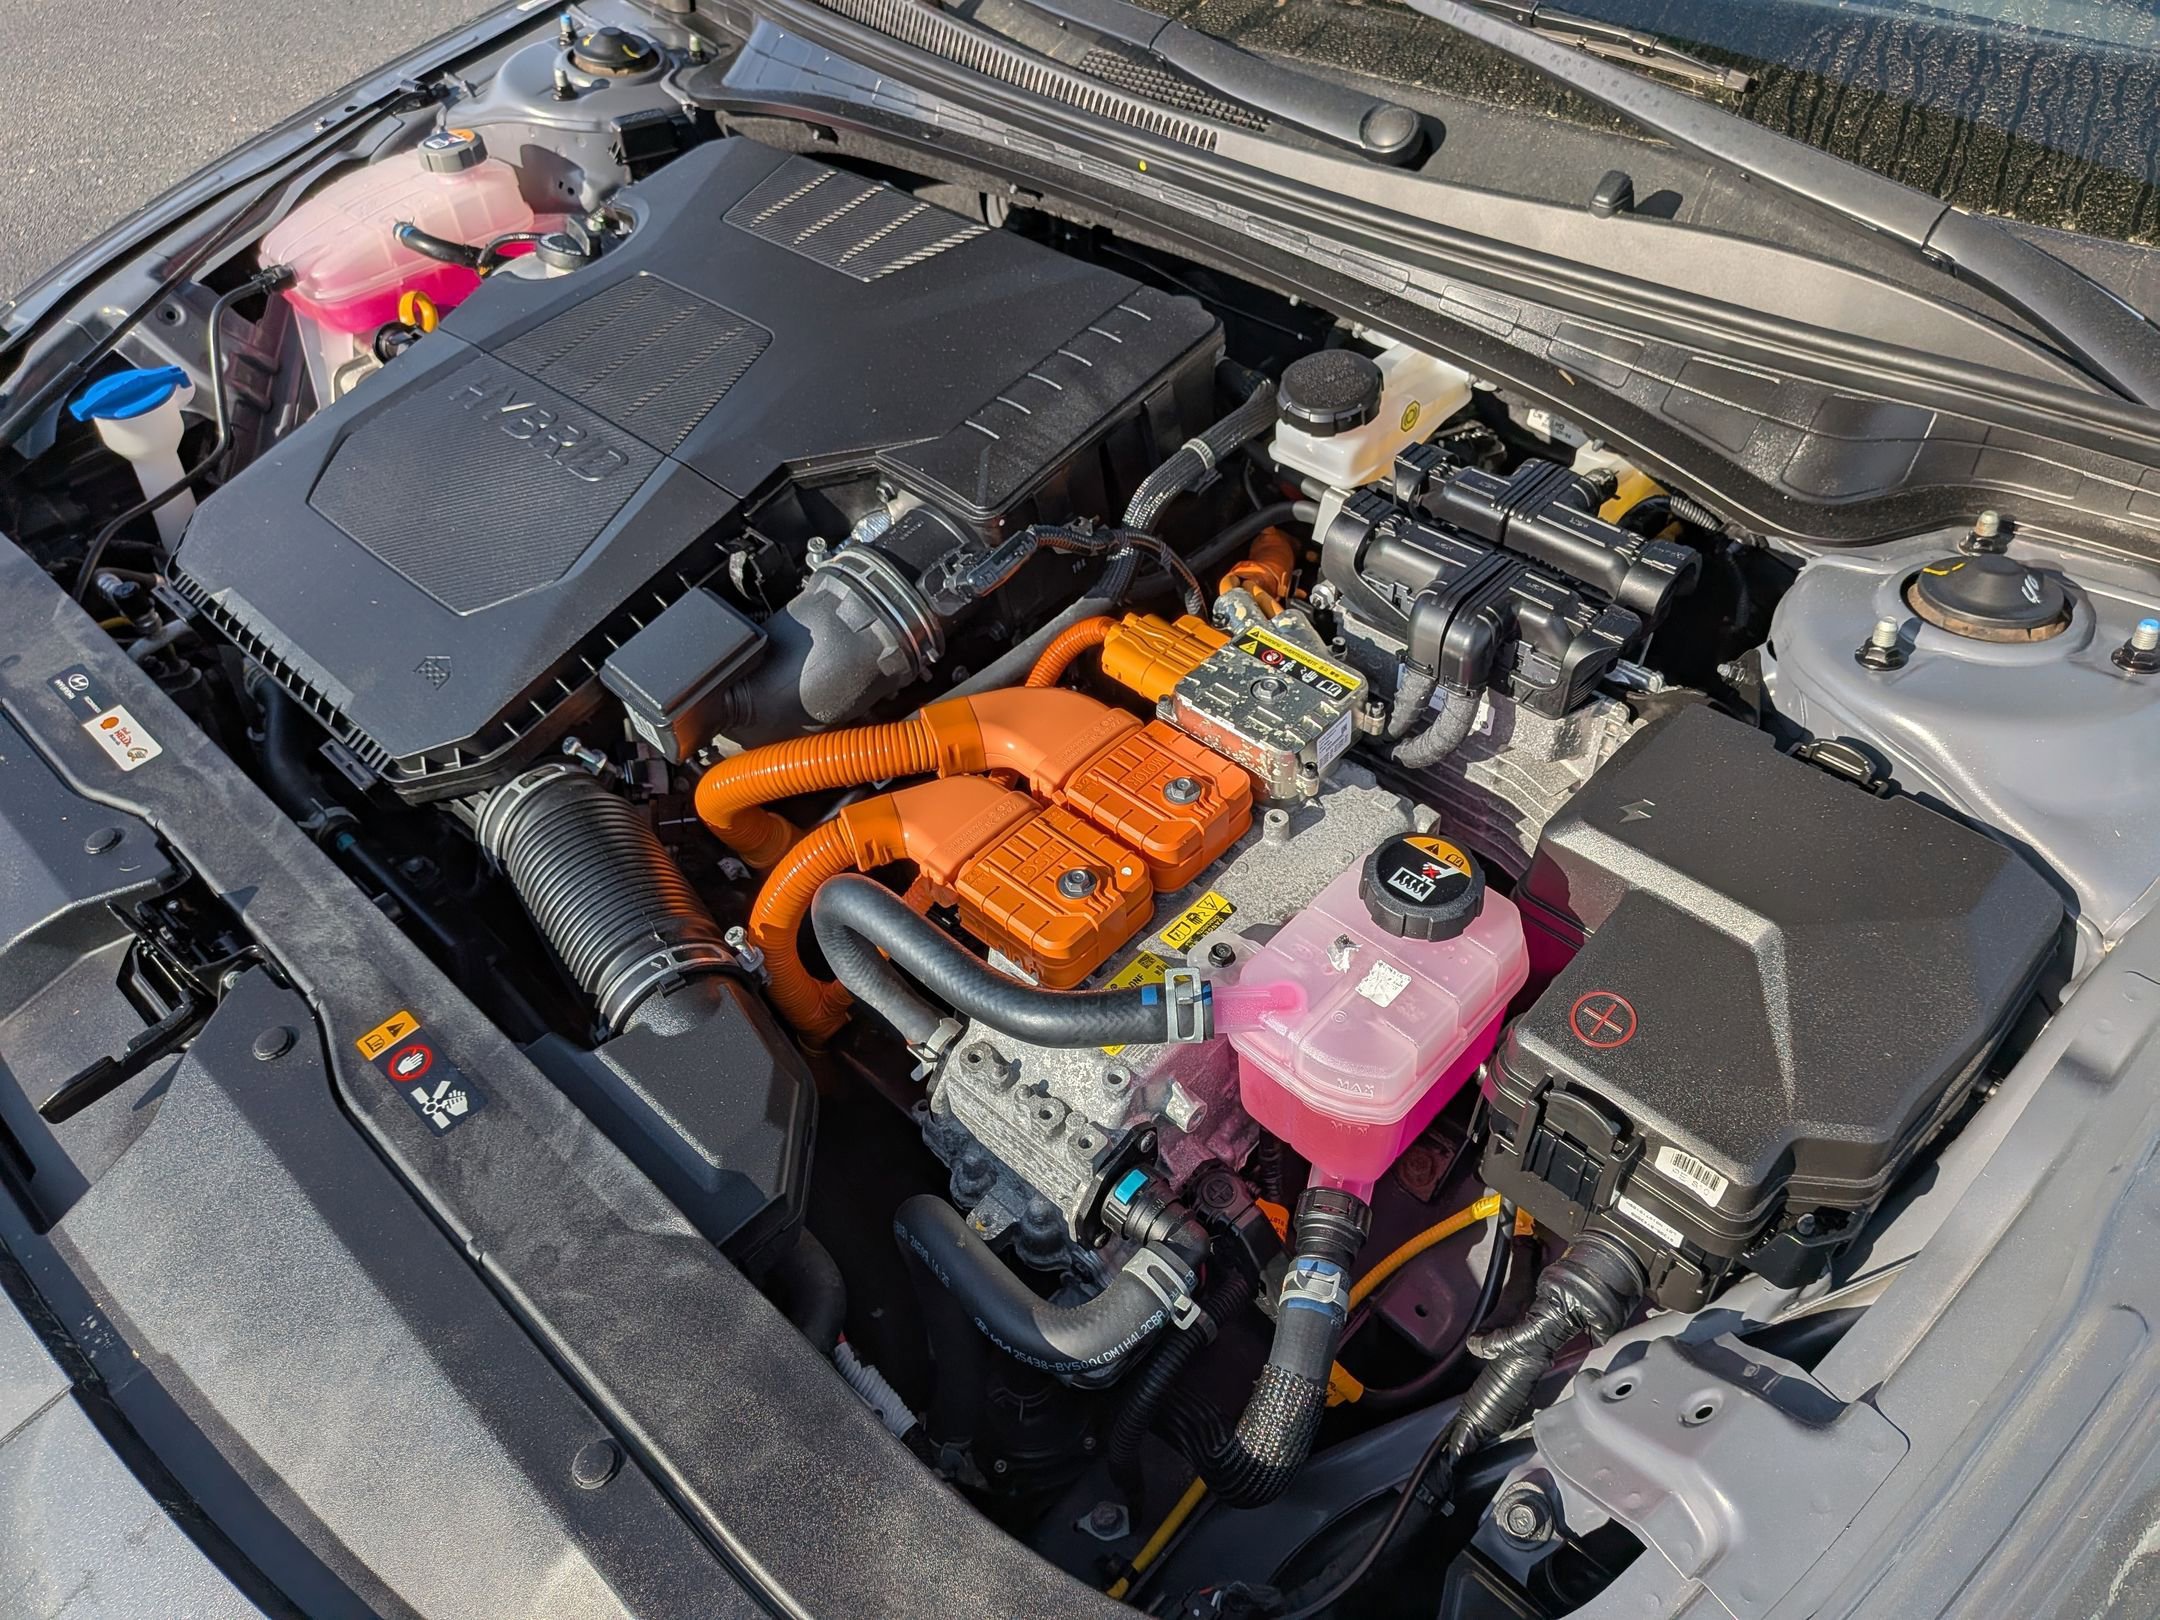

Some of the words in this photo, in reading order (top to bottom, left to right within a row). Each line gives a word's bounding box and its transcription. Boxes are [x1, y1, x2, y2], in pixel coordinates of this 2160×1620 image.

[449, 375, 629, 482] HYBRID
[54, 679, 76, 700] HYUNDAI
[1127, 755, 1169, 787] MOTOR
[1020, 843, 1068, 878] HSG
[1337, 1078, 1374, 1095] MAX
[1330, 1120, 1368, 1136] MIN
